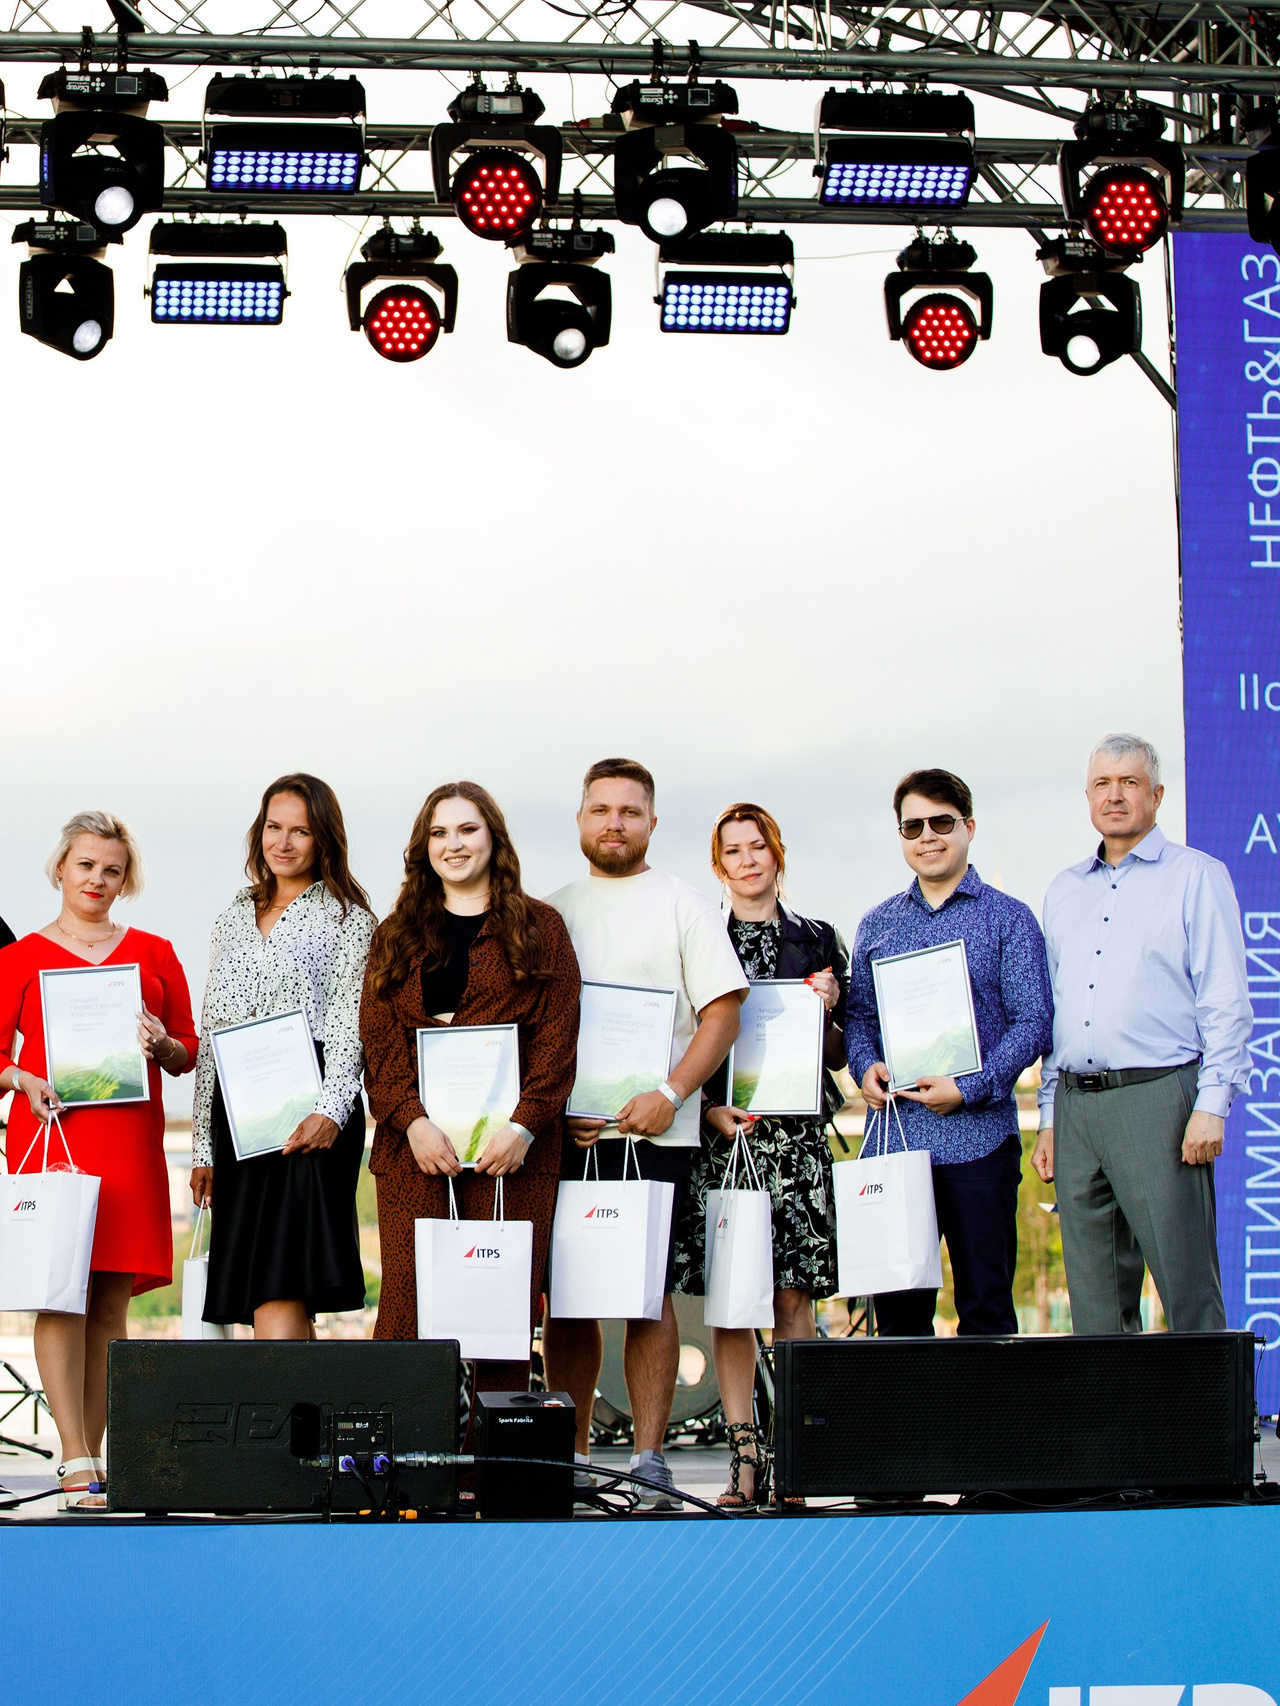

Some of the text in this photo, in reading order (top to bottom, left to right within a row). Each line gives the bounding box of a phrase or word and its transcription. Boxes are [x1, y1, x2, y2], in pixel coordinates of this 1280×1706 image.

[867, 1183, 883, 1194] ITPS
[21, 1200, 36, 1211] ITPS
[597, 1208, 619, 1218] ITPS
[476, 1248, 500, 1258] ITPS
